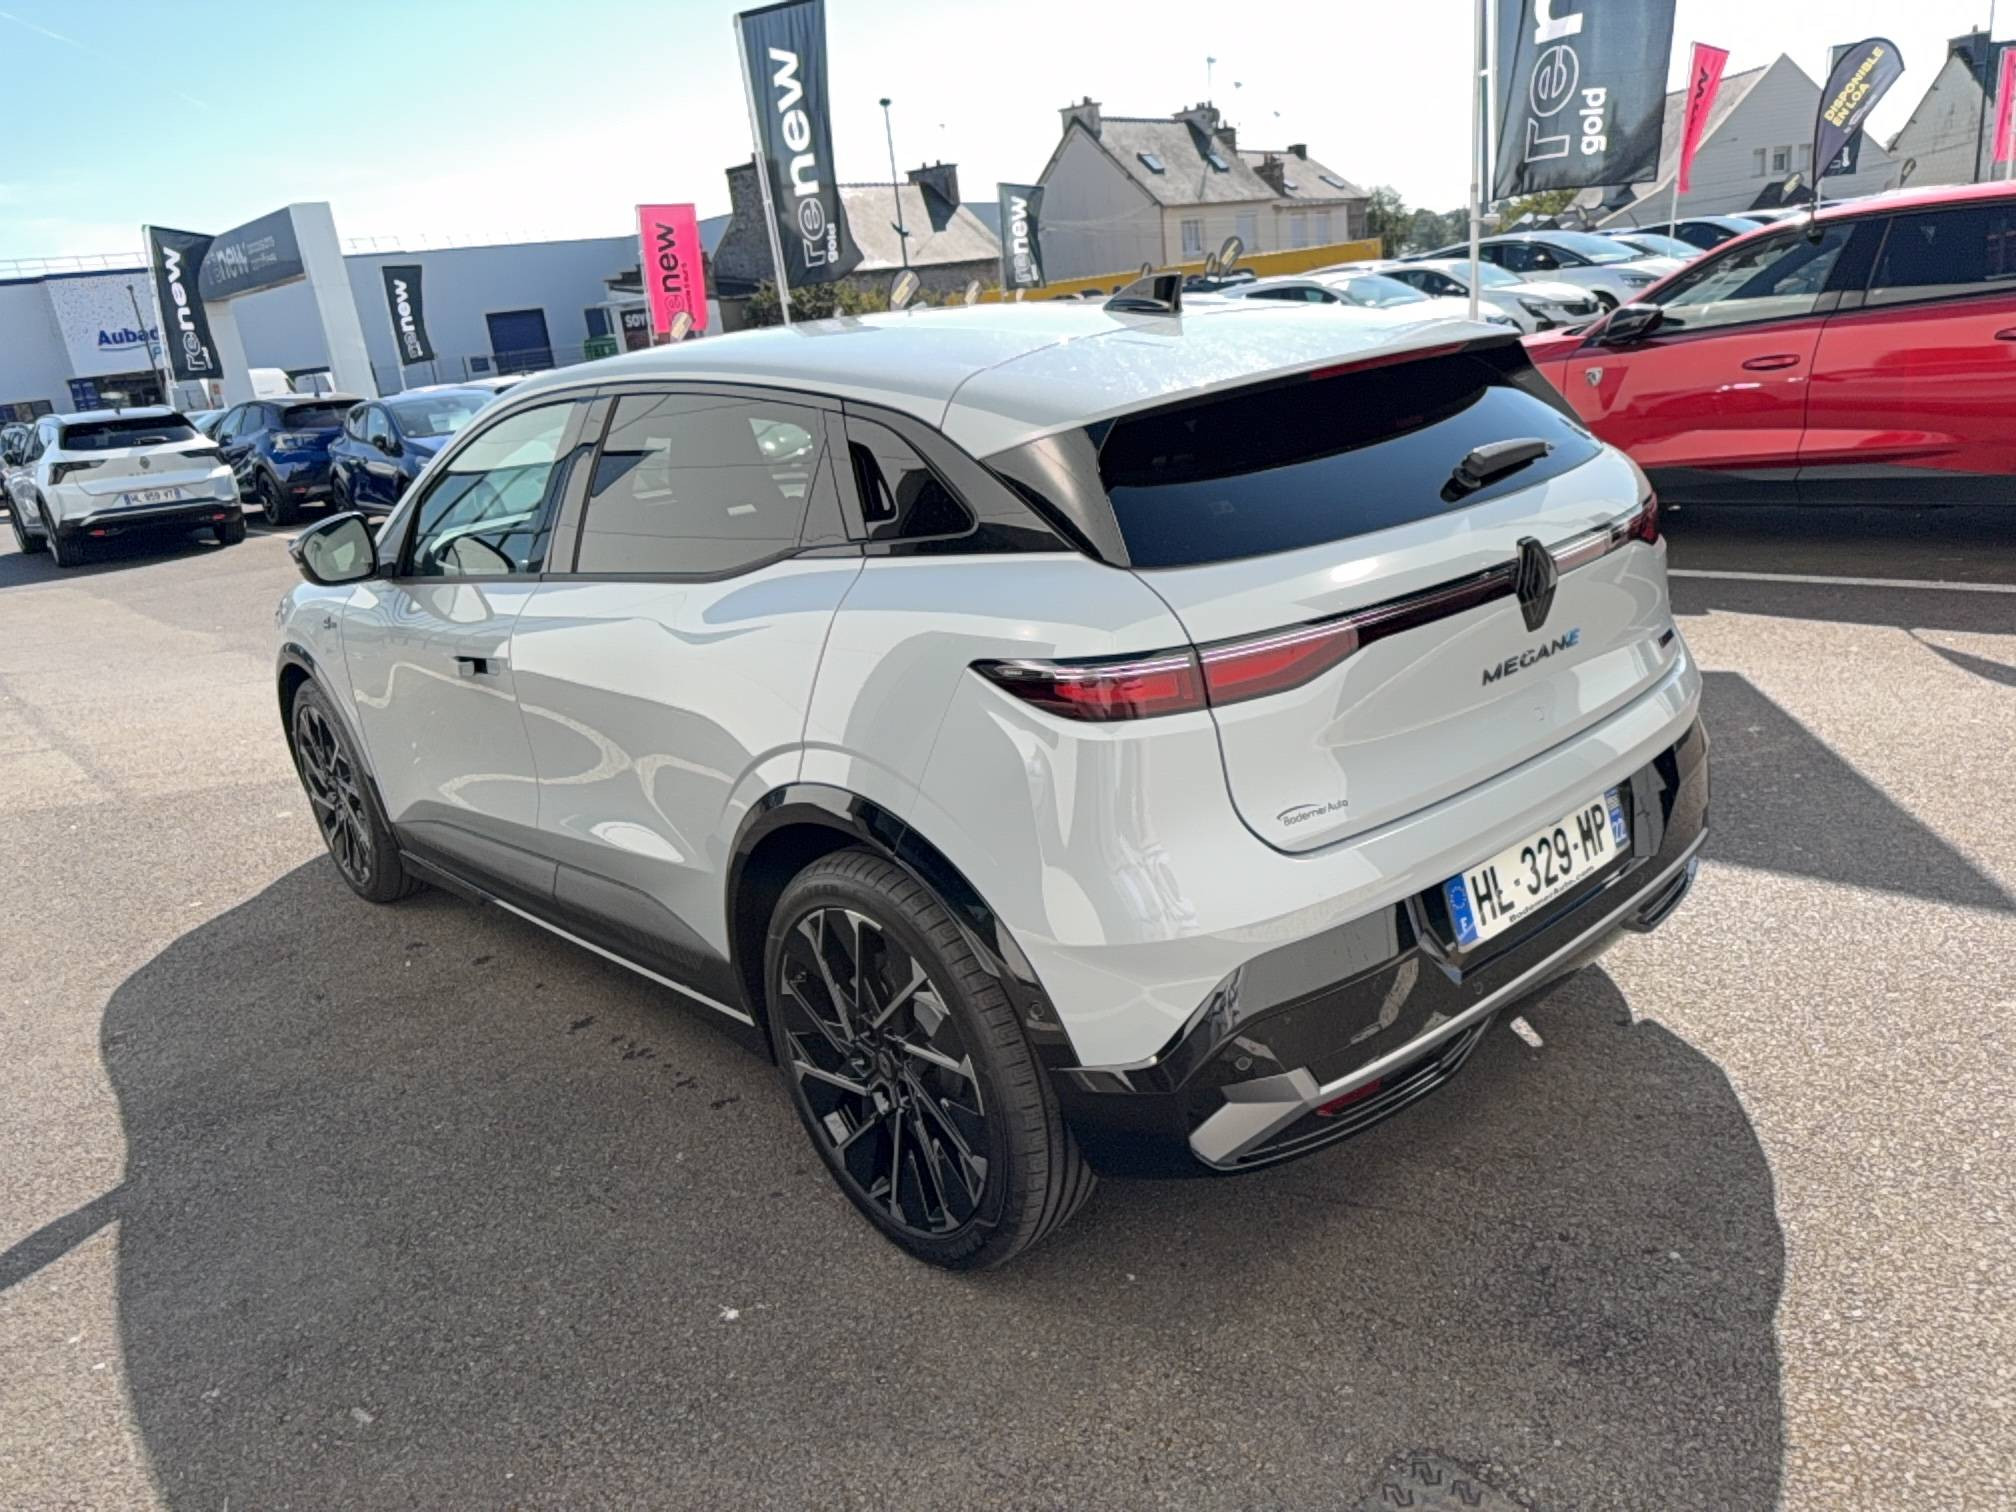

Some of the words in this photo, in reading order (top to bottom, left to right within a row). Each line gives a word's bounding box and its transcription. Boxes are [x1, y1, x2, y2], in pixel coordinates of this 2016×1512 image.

[1579, 87, 1607, 155] gold
[1823, 46, 1885, 121] DISPONIBLE
[1832, 105, 1850, 127] EN
[1846, 83, 1871, 109] LOA
[768, 47, 827, 267] renew
[826, 222, 839, 264] gold
[1010, 195, 1032, 283] renew
[163, 246, 206, 371] renew
[393, 279, 418, 359] renew
[1481, 627, 1580, 686] MEGANE
